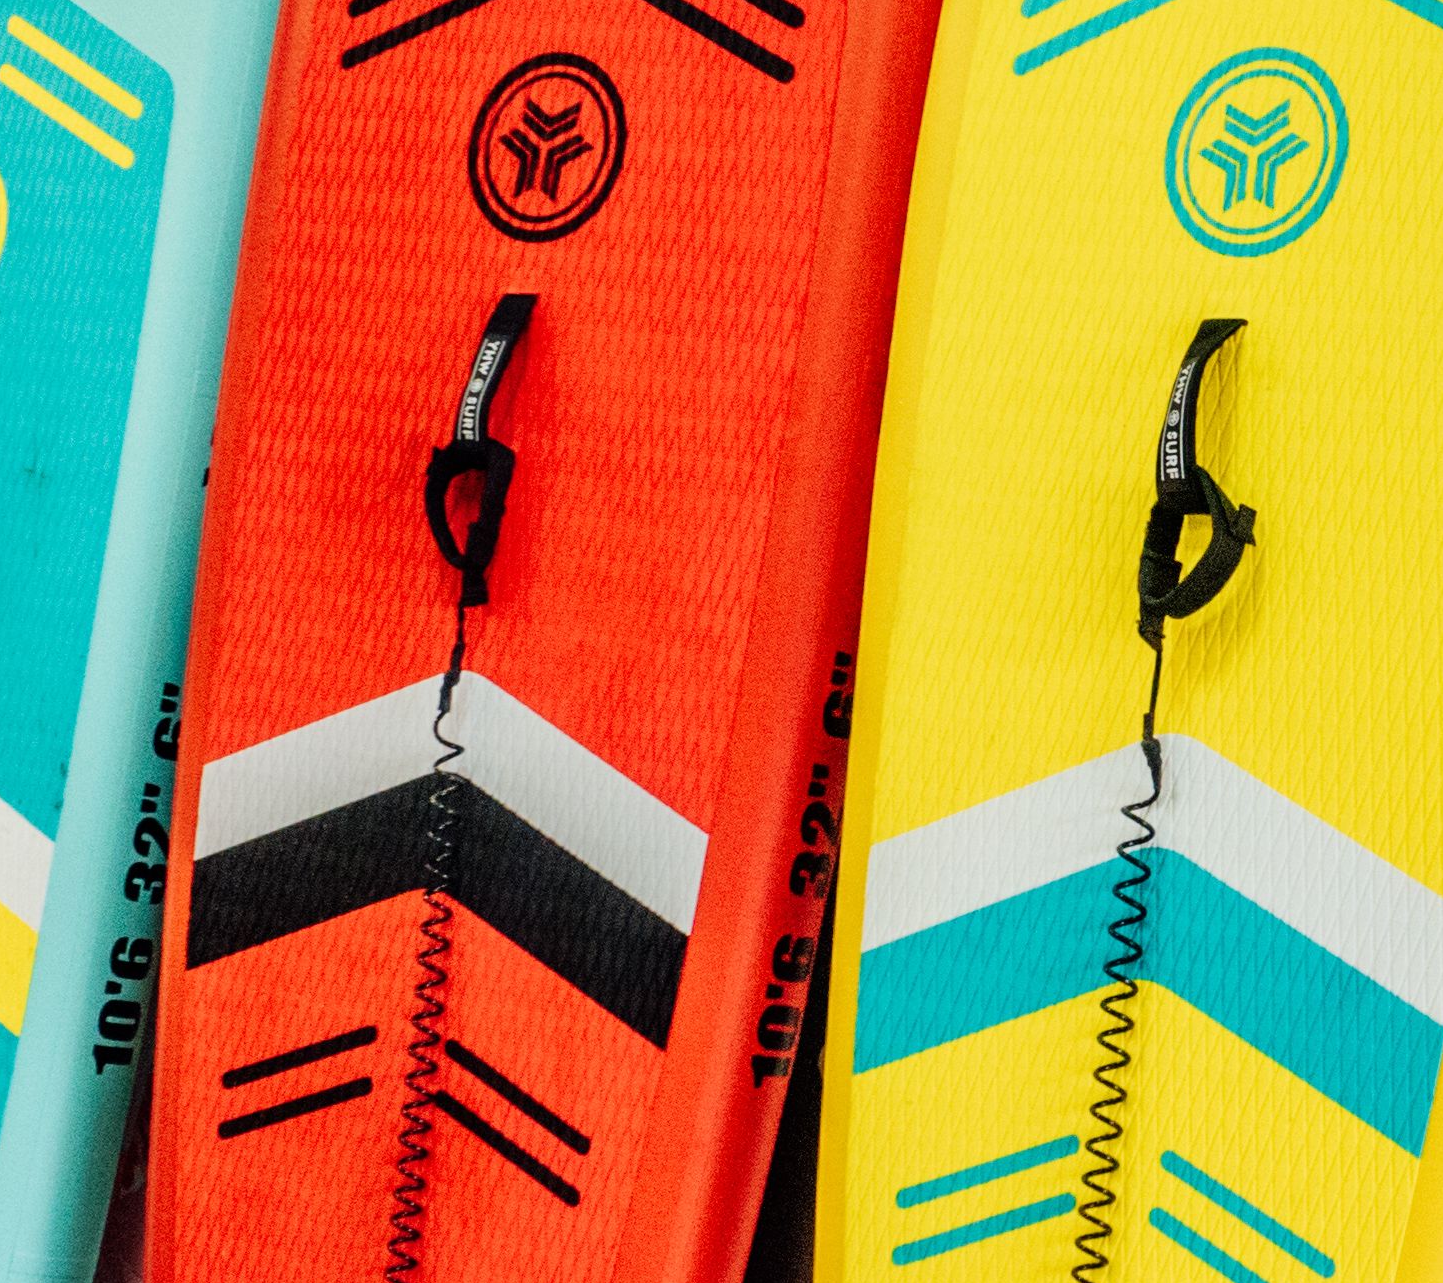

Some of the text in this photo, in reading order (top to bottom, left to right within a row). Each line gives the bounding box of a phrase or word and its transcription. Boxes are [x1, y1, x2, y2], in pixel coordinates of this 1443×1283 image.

[461, 338, 501, 440] YHW SURF
[1163, 431, 1179, 479] SURF
[92, 937, 153, 1075] 10'6
[124, 783, 170, 905] 32"
[751, 934, 814, 1089] 10'6
[789, 764, 844, 899] 32"
